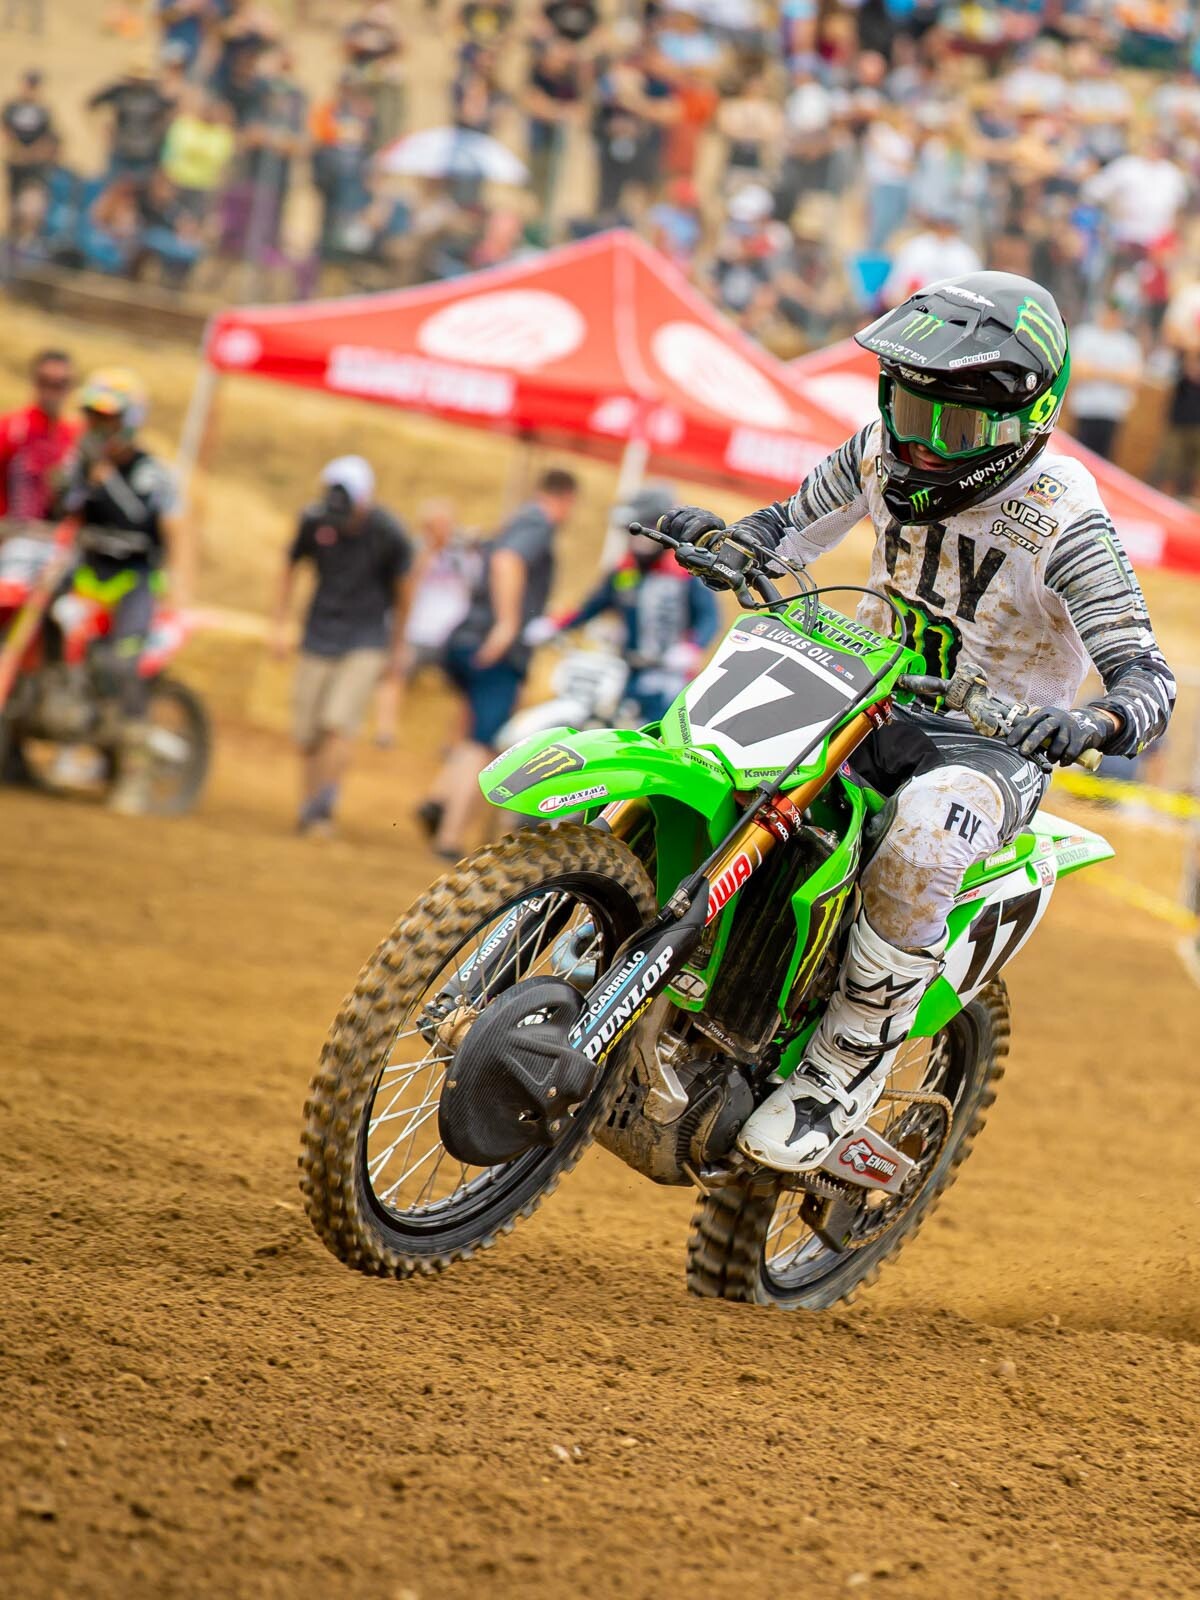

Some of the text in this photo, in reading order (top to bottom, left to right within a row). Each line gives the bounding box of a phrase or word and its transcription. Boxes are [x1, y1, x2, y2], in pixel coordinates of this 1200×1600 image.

[1001, 500, 1059, 538] WPS
[1001, 528, 1043, 554] SCOTT
[885, 520, 1007, 624] FLY
[766, 628, 812, 650] LUCAS
[807, 647, 834, 668] OIL
[689, 646, 853, 748] 17
[677, 705, 691, 745] Kawasaki
[558, 786, 606, 804] MAXIMA
[943, 802, 982, 845] FLY
[1056, 847, 1089, 866] DUNLOP
[957, 888, 1042, 995] 17
[590, 950, 646, 1015] CARRILLO
[583, 945, 674, 1061] DUNLOP
[707, 1021, 737, 1048] Twin Air
